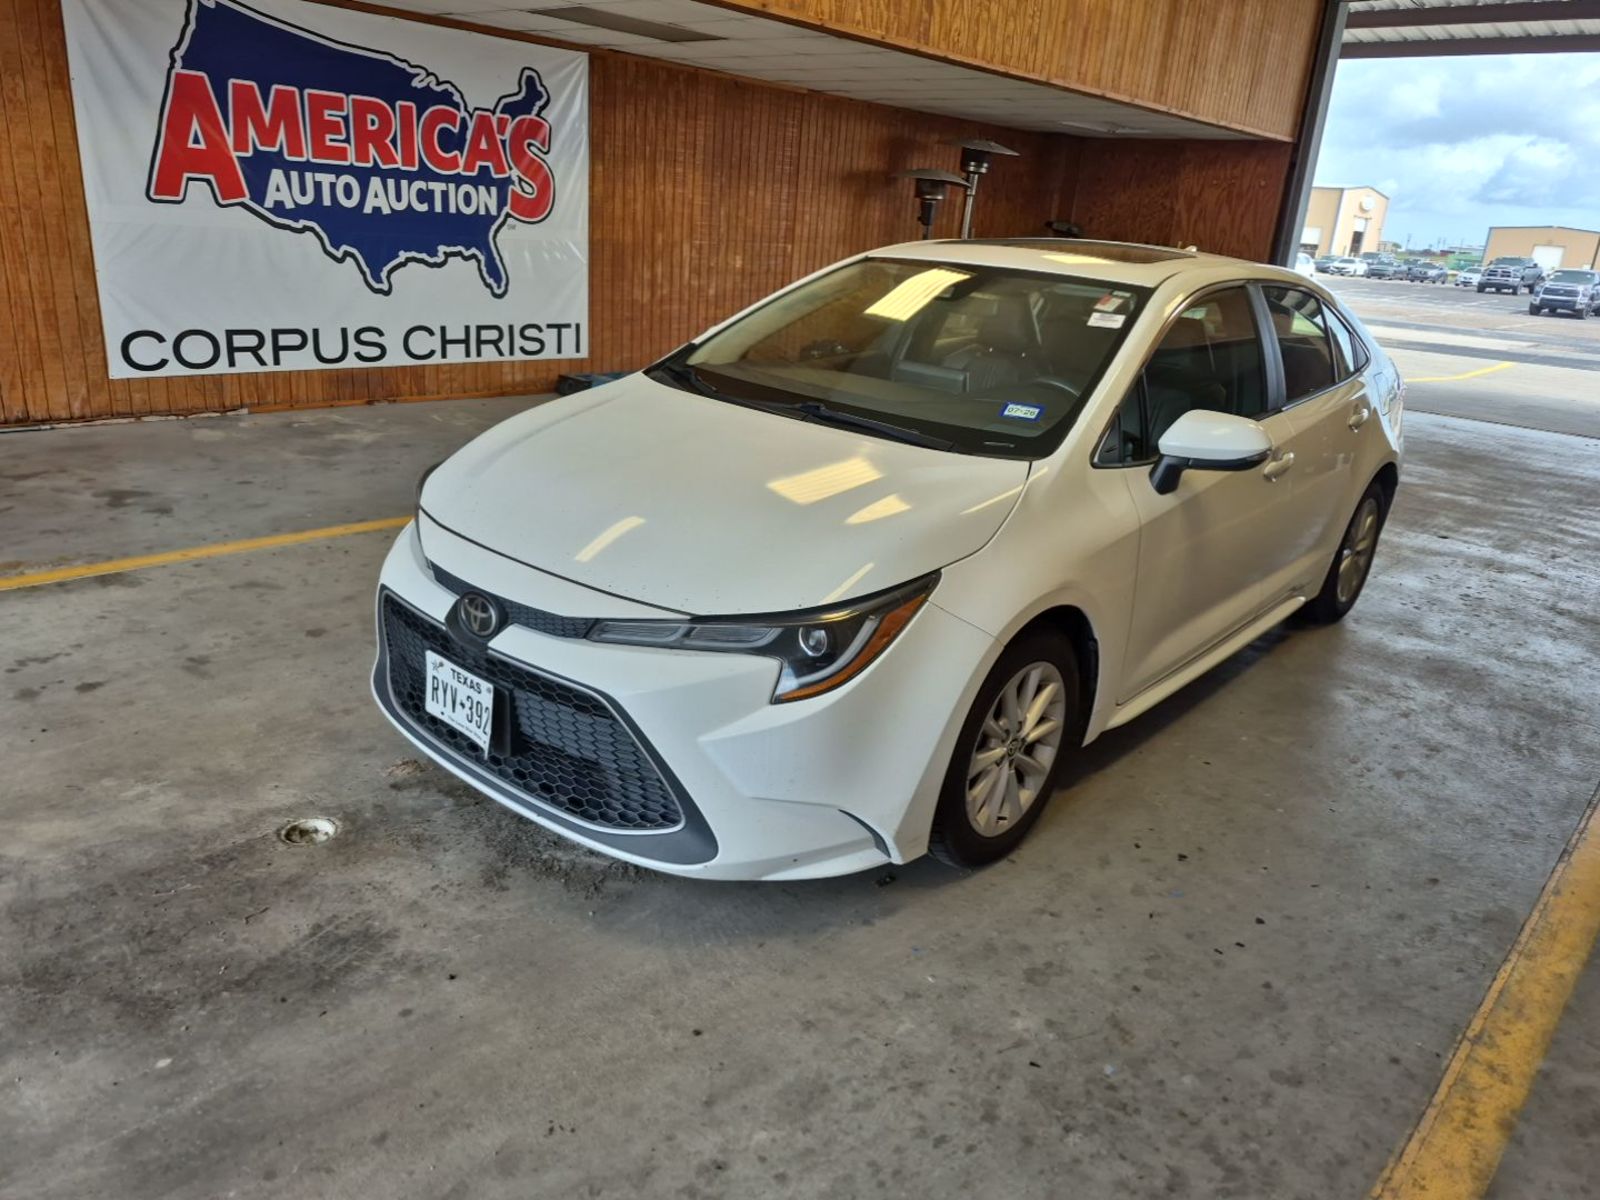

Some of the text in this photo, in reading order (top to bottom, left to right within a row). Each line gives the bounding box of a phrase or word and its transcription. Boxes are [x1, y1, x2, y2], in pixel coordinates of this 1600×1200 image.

[151, 70, 553, 222] AMERICA'S
[264, 169, 498, 216] AUTO AUCTION
[120, 323, 582, 371] CORPUS CHRISTI
[450, 667, 483, 695] TEXAS
